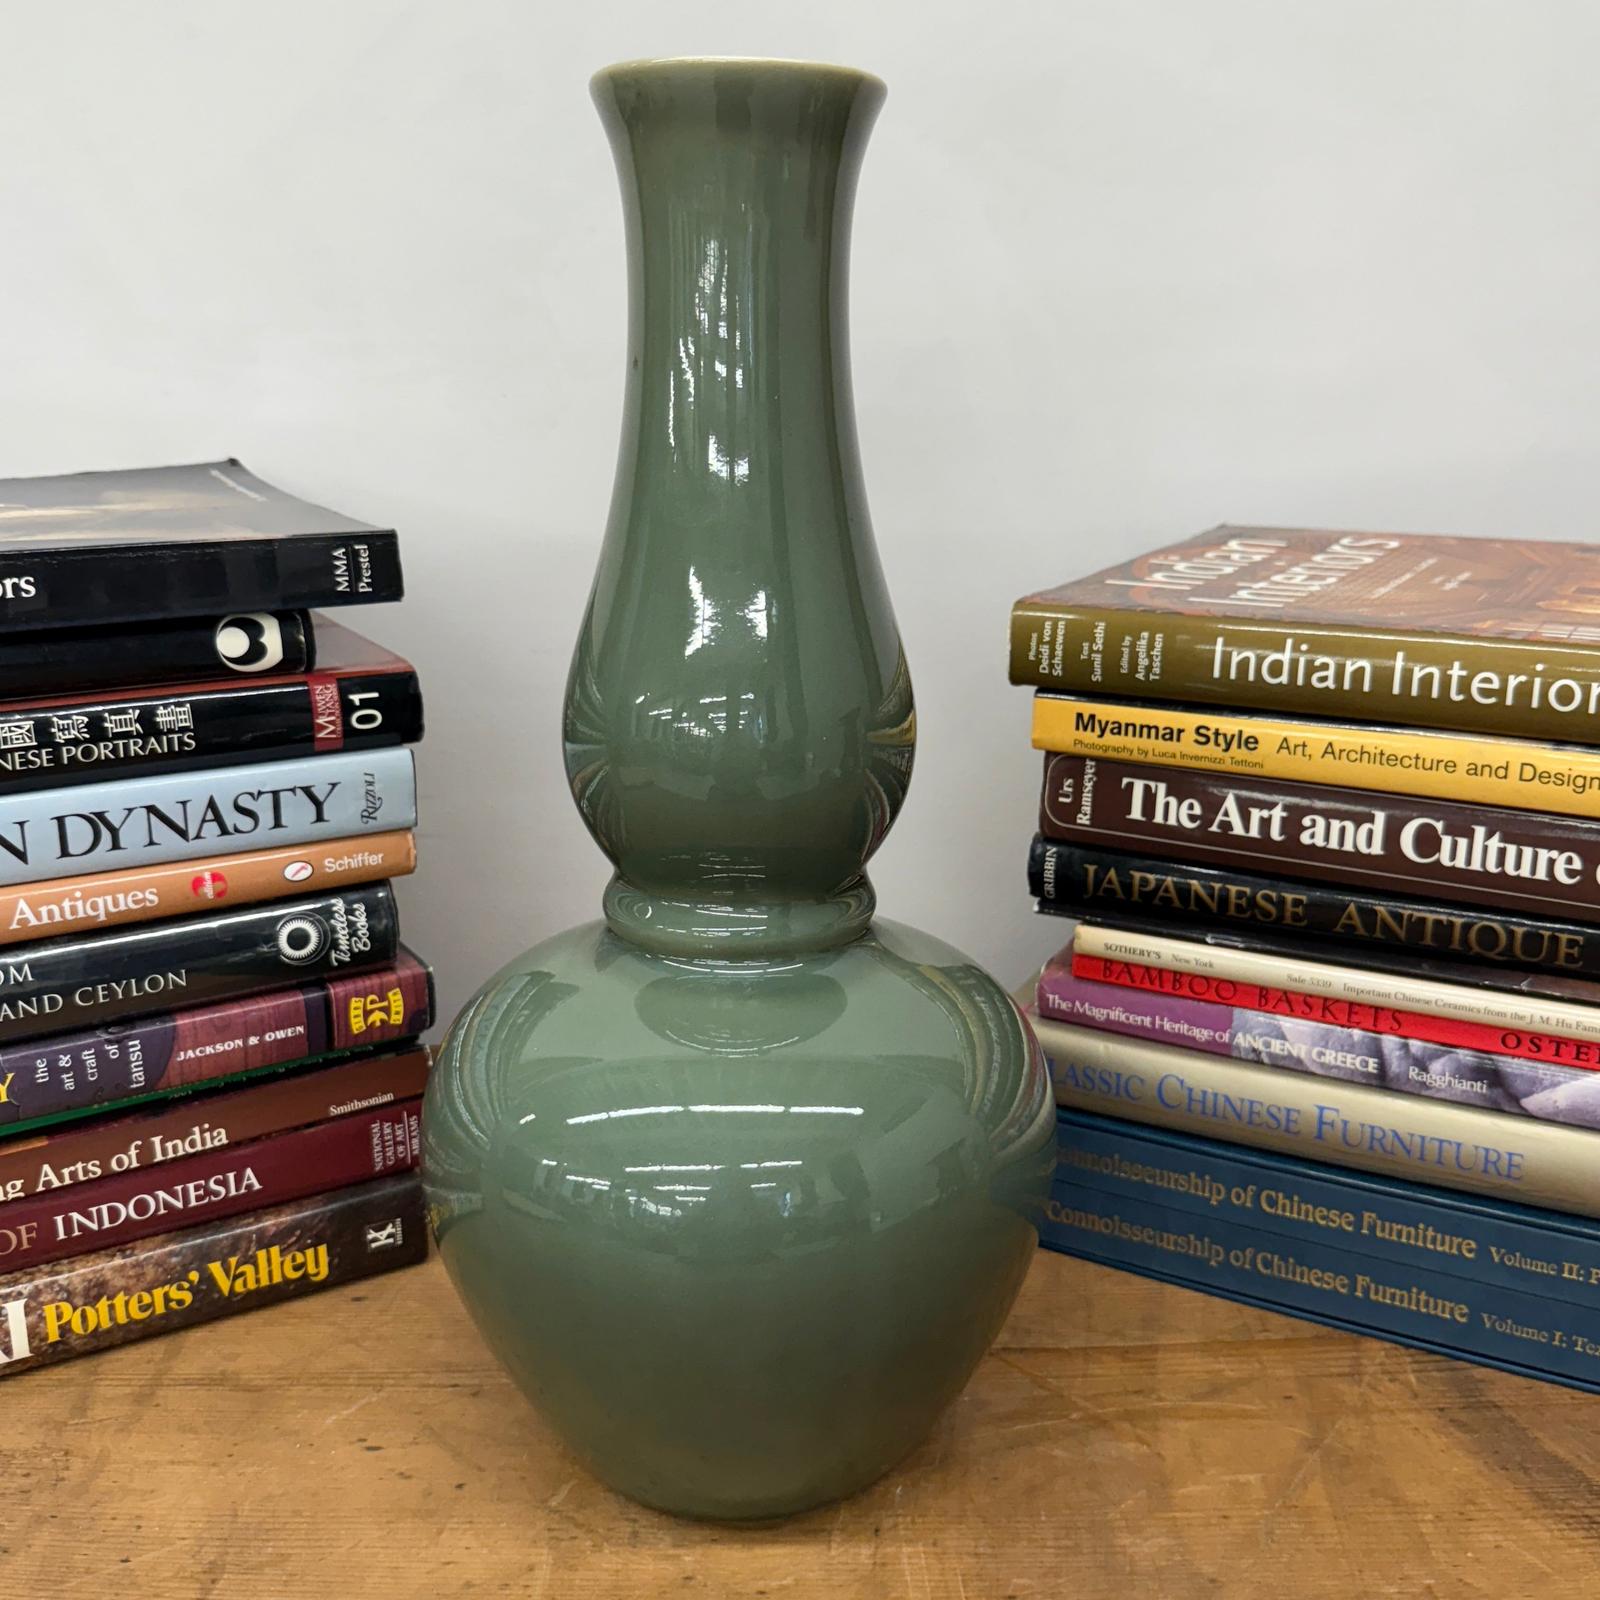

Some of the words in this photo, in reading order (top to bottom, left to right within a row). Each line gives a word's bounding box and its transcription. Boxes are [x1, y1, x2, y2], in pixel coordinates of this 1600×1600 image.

[332, 547, 350, 592] MMA
[353, 544, 373, 593] Prestel
[1104, 538, 1289, 590] Indian
[1187, 535, 1400, 607] Interiors
[0, 576, 36, 599] rs
[1043, 620, 1053, 643] von
[1052, 620, 1066, 677] Schaewen
[1080, 642, 1090, 660] Text
[1093, 621, 1106, 652] Sethi
[1121, 635, 1133, 648] by
[1039, 644, 1050, 674] Deidi
[1091, 653, 1103, 682] Sunil
[1120, 648, 1131, 674] Edited
[1135, 631, 1150, 681] Angelika
[1149, 633, 1164, 682] Taschen
[1212, 635, 1372, 694] Indian
[1392, 650, 1600, 714] Interior
[348, 691, 383, 730] 01
[62, 732, 196, 765] PORTRAITS
[1073, 738, 1135, 760] Photography
[1137, 747, 1150, 761] by
[1151, 747, 1178, 761] Luca
[1179, 751, 1226, 766] Invernizzi
[1228, 756, 1264, 770] Tettoni
[1075, 711, 1184, 744] Myanmar
[1193, 724, 1259, 755] Style
[1276, 734, 1313, 762] Art,
[1321, 741, 1457, 776] Architecture
[1465, 760, 1509, 781] and
[1518, 762, 1600, 794] Design
[1058, 778, 1074, 804] Urs
[1076, 758, 1098, 826] Ramseyer
[50, 781, 342, 860] DYNASTY
[1121, 776, 1202, 830] The
[1208, 792, 1288, 842] Art
[1299, 811, 1385, 856] and
[1400, 816, 1584, 886] Culture
[324, 852, 385, 874] Schiffer
[1044, 846, 1058, 900] GRIBBIN
[9, 886, 160, 931] Antiques
[347, 902, 372, 954] Books
[1083, 863, 1308, 926] JAPANESE
[1333, 906, 1585, 969] ANTIQUE
[329, 896, 351, 967] Timeless
[0, 962, 35, 986] M
[0, 993, 63, 1022] AND
[74, 969, 188, 1007] CEYLON
[1102, 958, 1238, 1001] BAMBOO
[1257, 986, 1403, 1032] BASKETS
[1103, 942, 1162, 960] SOTHEBY'S
[1170, 953, 1192, 964] New
[1193, 957, 1215, 969] York
[1286, 973, 1307, 985] Sale
[1343, 982, 1392, 1000] Important
[1394, 991, 1433, 1006] Chinese
[1434, 998, 1482, 1014] Ceramics
[1483, 1006, 1507, 1018] from
[1509, 1009, 1527, 1022] the
[1555, 1017, 1573, 1029] Hu
[104, 1043, 120, 1059] of
[176, 1037, 244, 1062] JACKSON
[248, 1033, 260, 1046] &
[264, 1024, 305, 1043] OWEN
[1046, 993, 1073, 1013] The
[1074, 1000, 1153, 1028] Magnificent
[1155, 1015, 1216, 1043] Heritage
[1216, 1029, 1232, 1043] of
[1233, 1031, 1308, 1062] ANCIENT
[1311, 1046, 1379, 1074] GREECE
[35, 1058, 50, 1083] the
[58, 1053, 73, 1067] &
[60, 1071, 76, 1091] art
[82, 1048, 98, 1081] craft
[128, 1039, 146, 1089] tansu
[1408, 1065, 1489, 1094] Ragghianti
[329, 1091, 395, 1116] Smithsonian
[1049, 1058, 1145, 1101] LASSIC
[1156, 1073, 1301, 1135] CHINESE
[1314, 1104, 1525, 1182] FURNITURE
[371, 1119, 384, 1172] NATIONAL
[384, 1121, 395, 1165] GALLERY
[394, 1122, 405, 1144] ART
[396, 1144, 406, 1158] OF
[409, 1115, 420, 1155] ABRAMS
[36, 1160, 102, 1192] Arts
[111, 1140, 142, 1172] of
[150, 1124, 229, 1162] India
[52, 1167, 263, 1242] INDONESIA
[1057, 1147, 1227, 1206] onnoisseurship
[1230, 1184, 1257, 1208] of
[1260, 1189, 1355, 1231] Chinese
[1361, 1211, 1477, 1258] Furniture
[1488, 1245, 1559, 1275] Volume
[1561, 1261, 1585, 1281] II:
[207, 1242, 331, 1298] Valley
[1043, 1200, 1225, 1267] Connoisseurship
[1229, 1247, 1256, 1271] of
[1255, 1252, 1350, 1296] Chinese
[1355, 1273, 1470, 1323] Furniture
[1481, 1312, 1549, 1342] Volume
